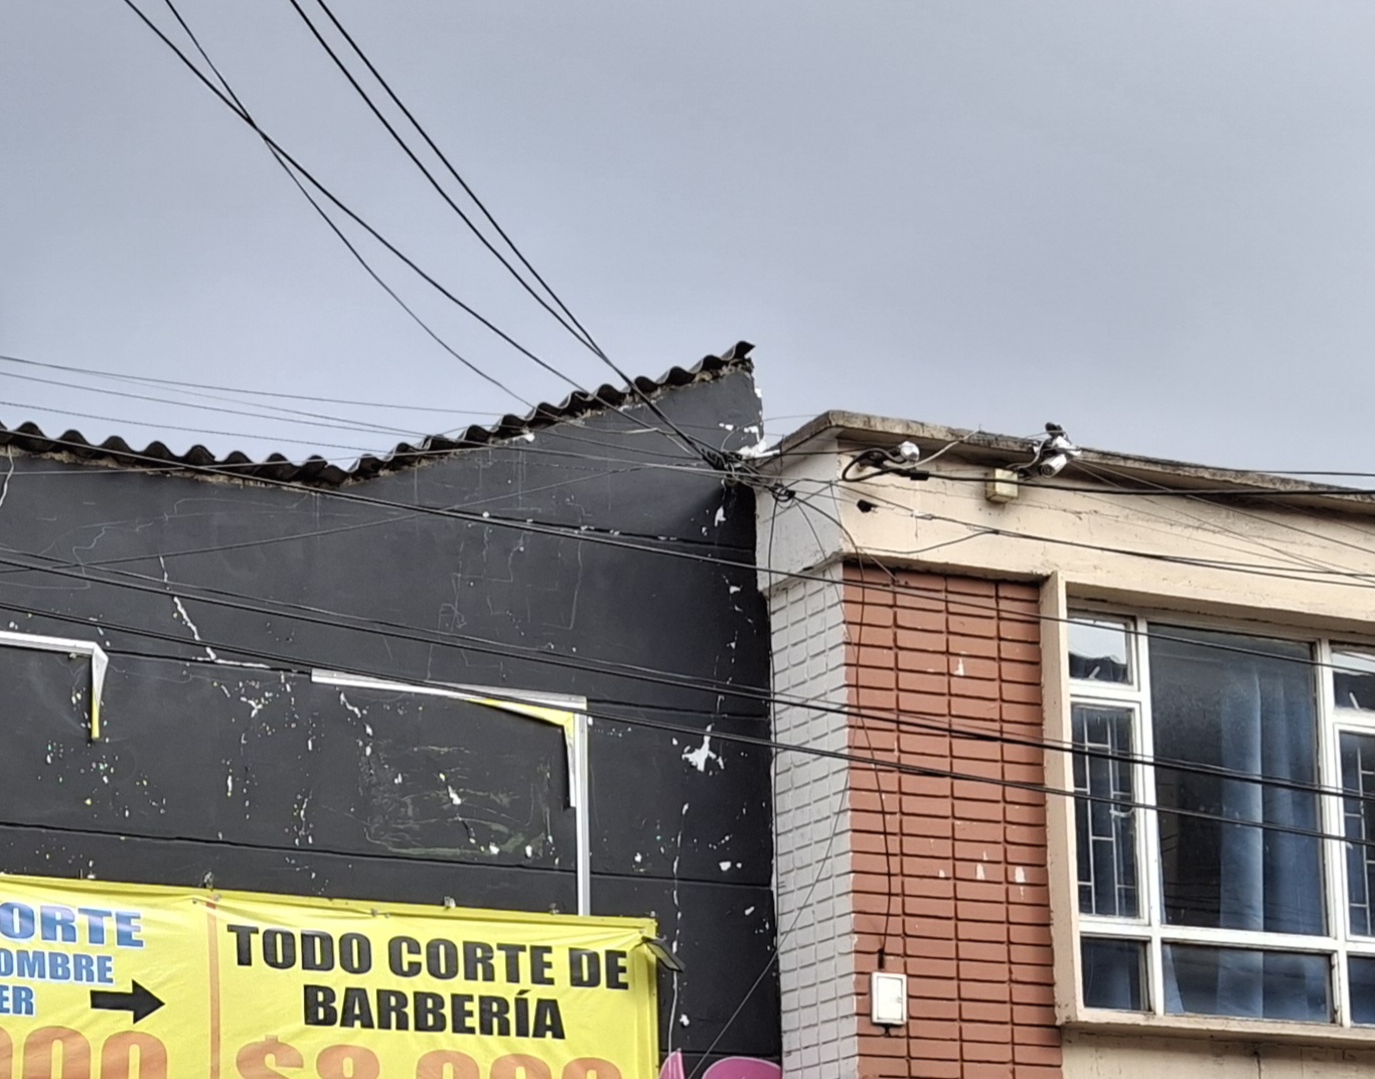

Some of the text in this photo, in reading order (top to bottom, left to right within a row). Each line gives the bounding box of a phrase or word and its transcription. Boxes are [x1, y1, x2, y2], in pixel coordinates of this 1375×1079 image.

[227, 924, 629, 990] TODO CORTE DE
[303, 983, 566, 1040] BARBERÍA
